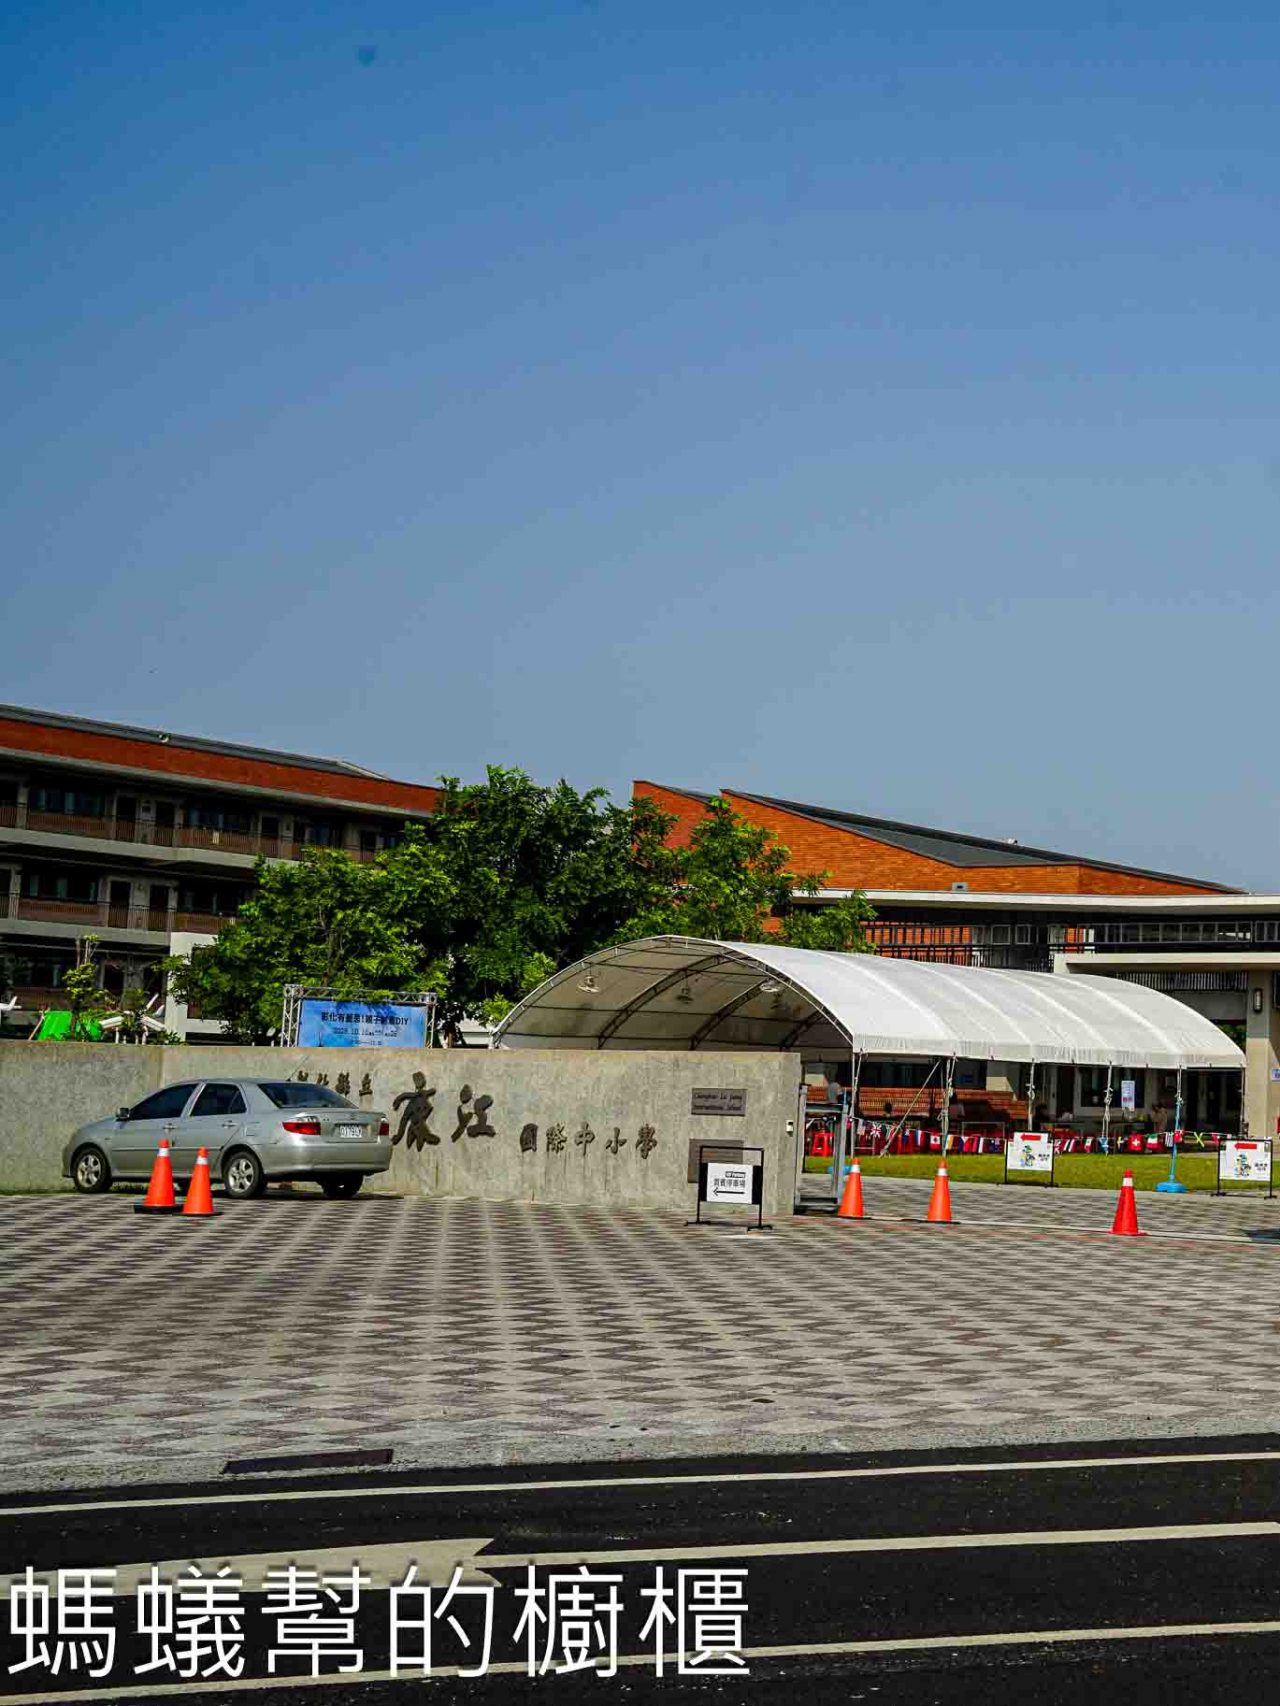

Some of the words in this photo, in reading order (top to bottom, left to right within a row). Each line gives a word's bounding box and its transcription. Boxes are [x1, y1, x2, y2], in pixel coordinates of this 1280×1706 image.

[519, 1122, 658, 1159] 國際中小學
